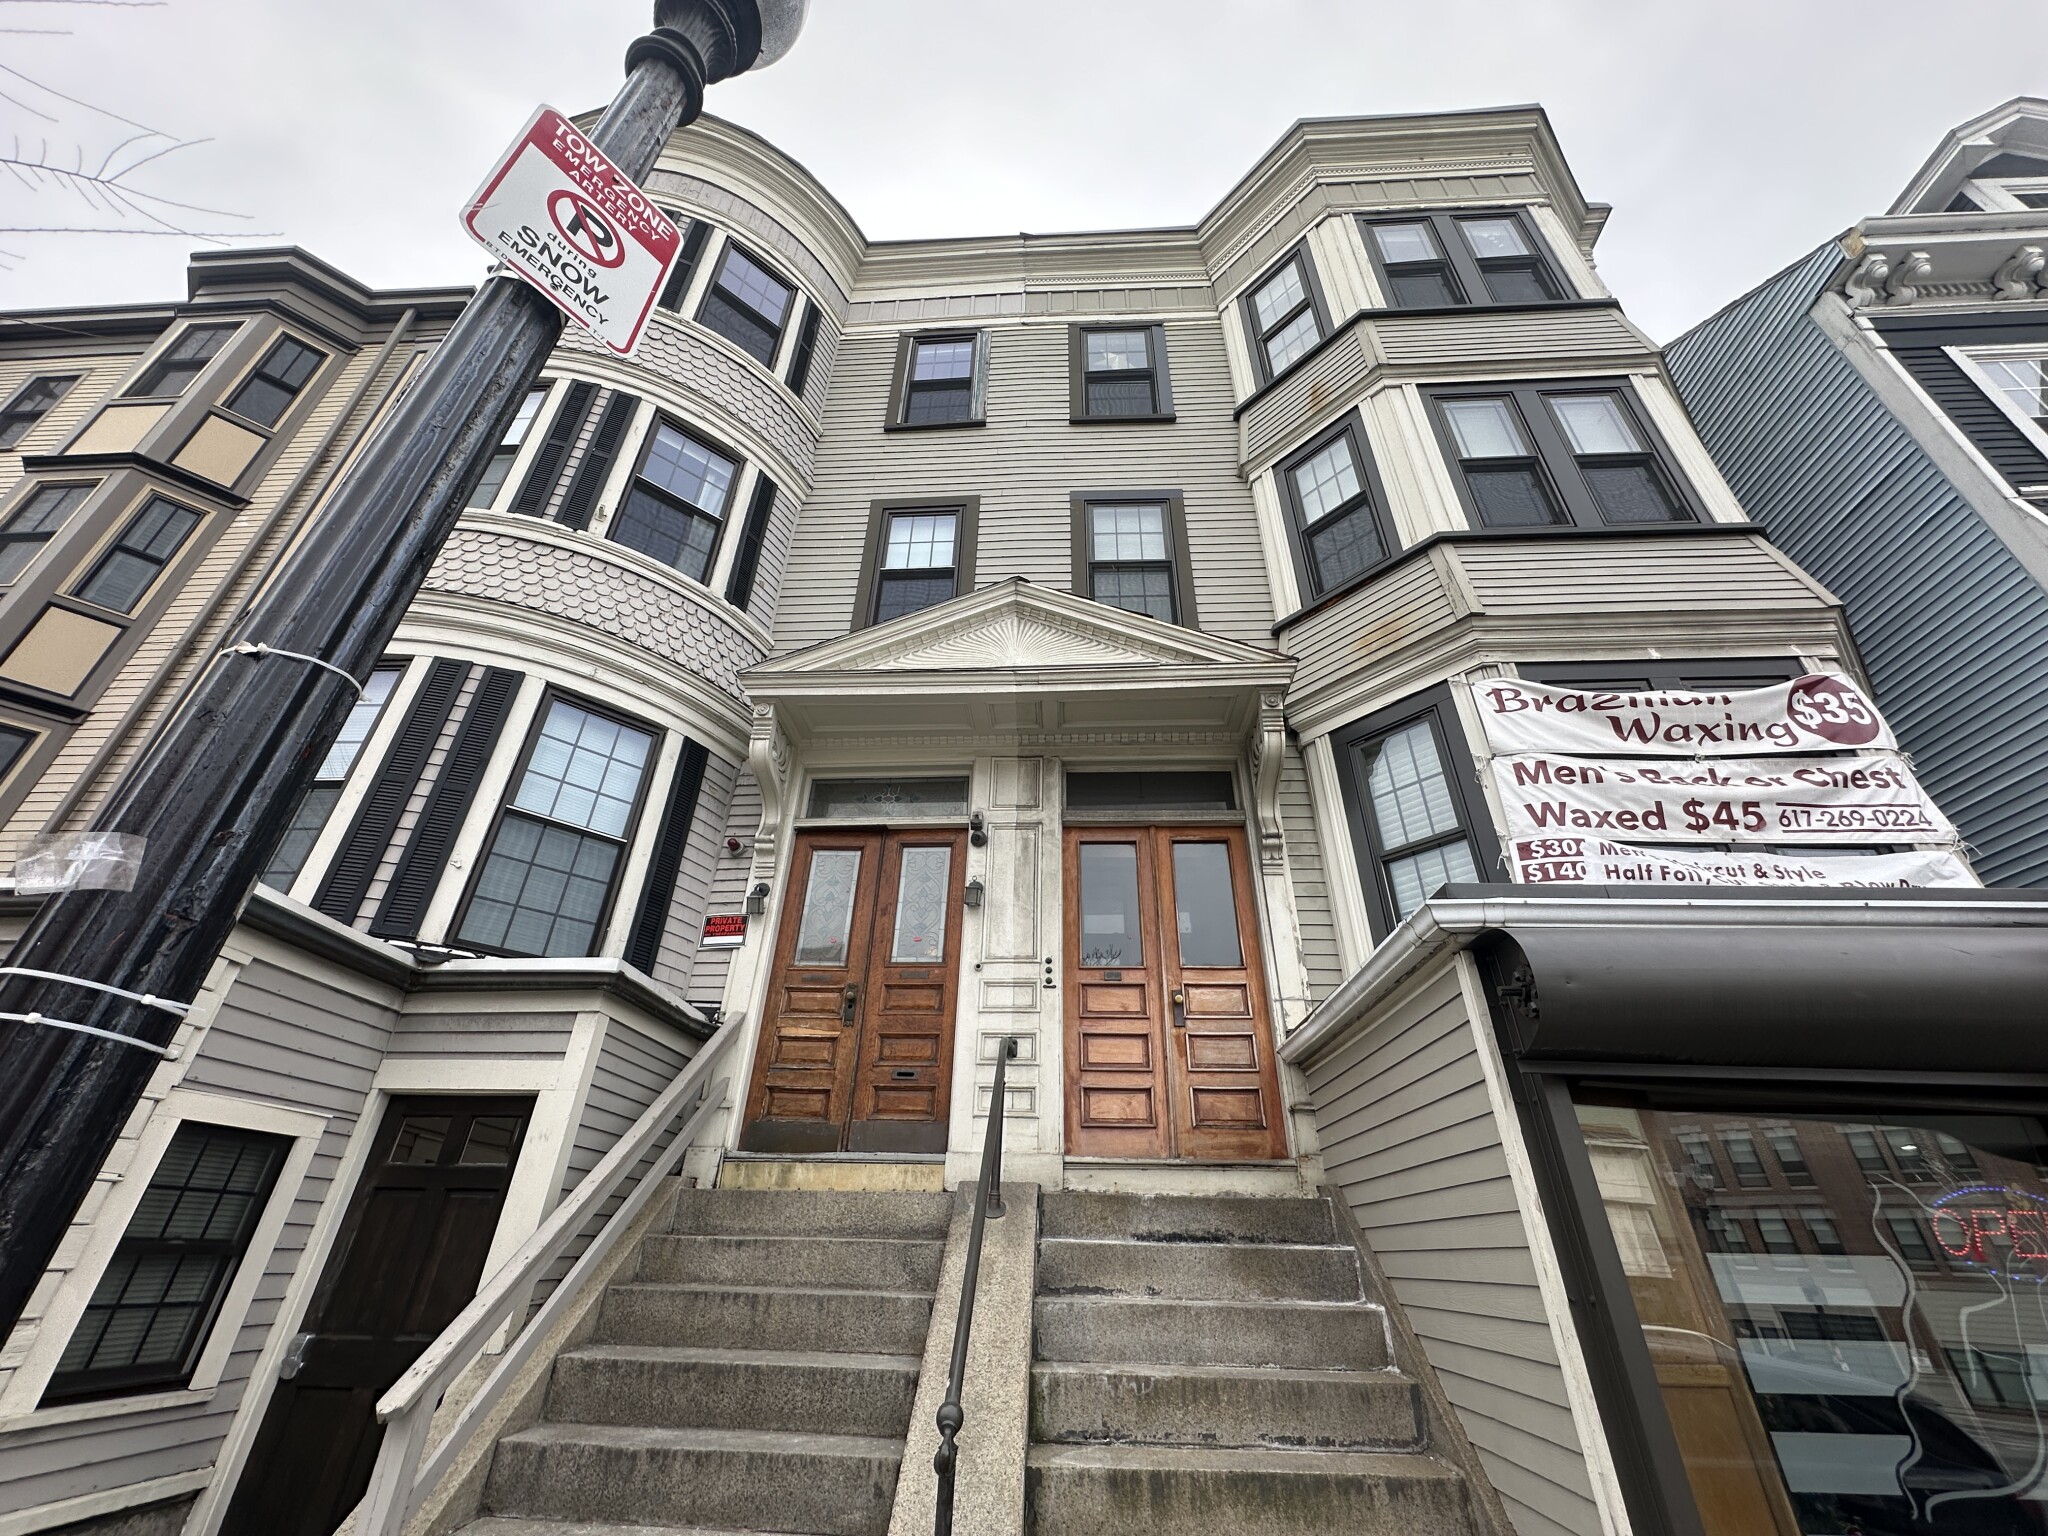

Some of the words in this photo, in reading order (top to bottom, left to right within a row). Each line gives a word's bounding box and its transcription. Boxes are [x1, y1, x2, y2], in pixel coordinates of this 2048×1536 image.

[552, 138, 660, 240] EMERGENCY
[556, 118, 608, 173] TOW
[612, 173, 673, 241] ZONE
[569, 170, 637, 231] ARTERY
[517, 225, 610, 305] SNOW
[547, 232, 597, 279] during
[498, 230, 609, 325] EMERGENCY
[1606, 711, 1799, 747] Waxing
[1791, 689, 1872, 730] $35
[1512, 760, 1636, 786] Men's
[1745, 776, 1788, 787] or
[1793, 767, 1907, 788] Chest
[1524, 801, 1667, 831] Waxed
[1682, 797, 1767, 834] $45
[1778, 808, 1933, 828] 617-269-0224
[1604, 863, 1653, 881] Half
[1753, 863, 1769, 878] &
[1772, 864, 1827, 882] Style
[705, 923, 746, 933] PROPERTY
[711, 916, 743, 925] PRIVATE
